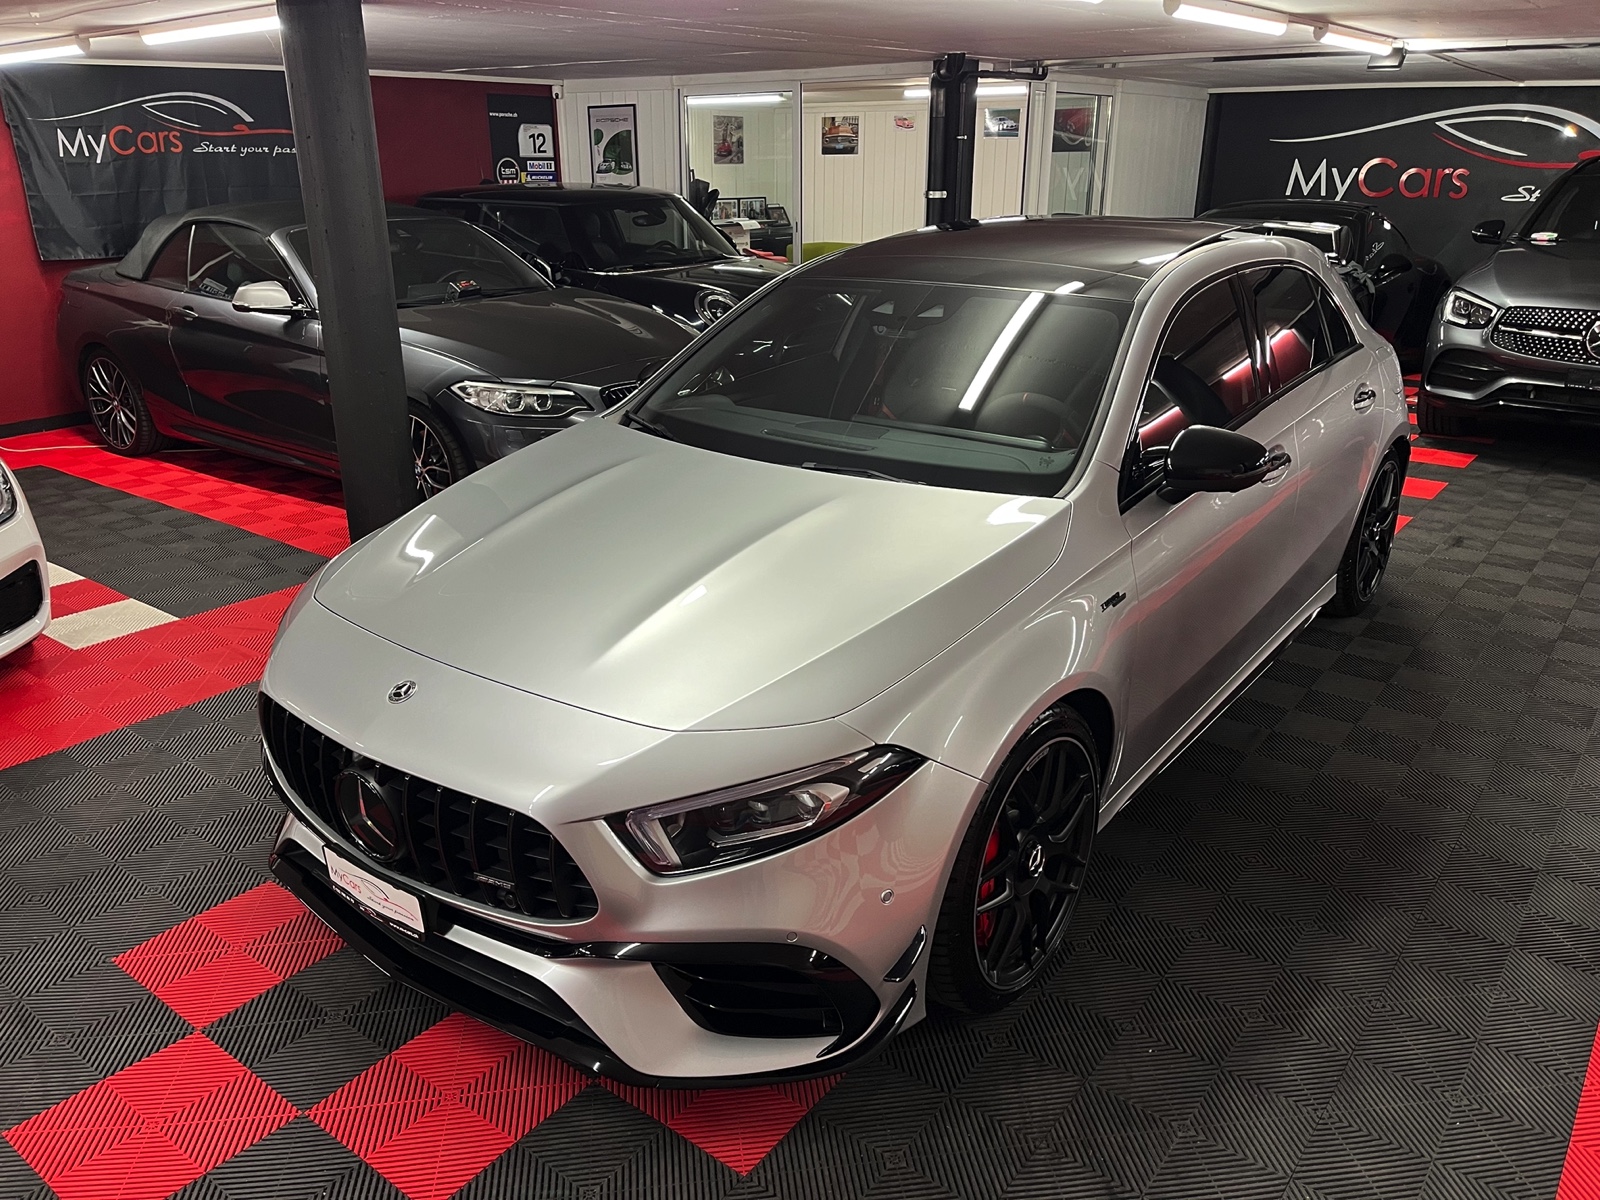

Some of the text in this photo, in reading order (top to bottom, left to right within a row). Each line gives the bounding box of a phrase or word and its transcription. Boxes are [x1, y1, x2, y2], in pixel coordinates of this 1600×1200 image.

[57, 124, 183, 164] MyCars
[193, 141, 237, 154] Start
[240, 144, 270, 157] your
[528, 132, 547, 154] 12
[501, 166, 516, 174] tsm
[528, 162, 546, 170] Mobil
[1285, 157, 1470, 202] MyCars
[330, 865, 362, 894] MyCars
